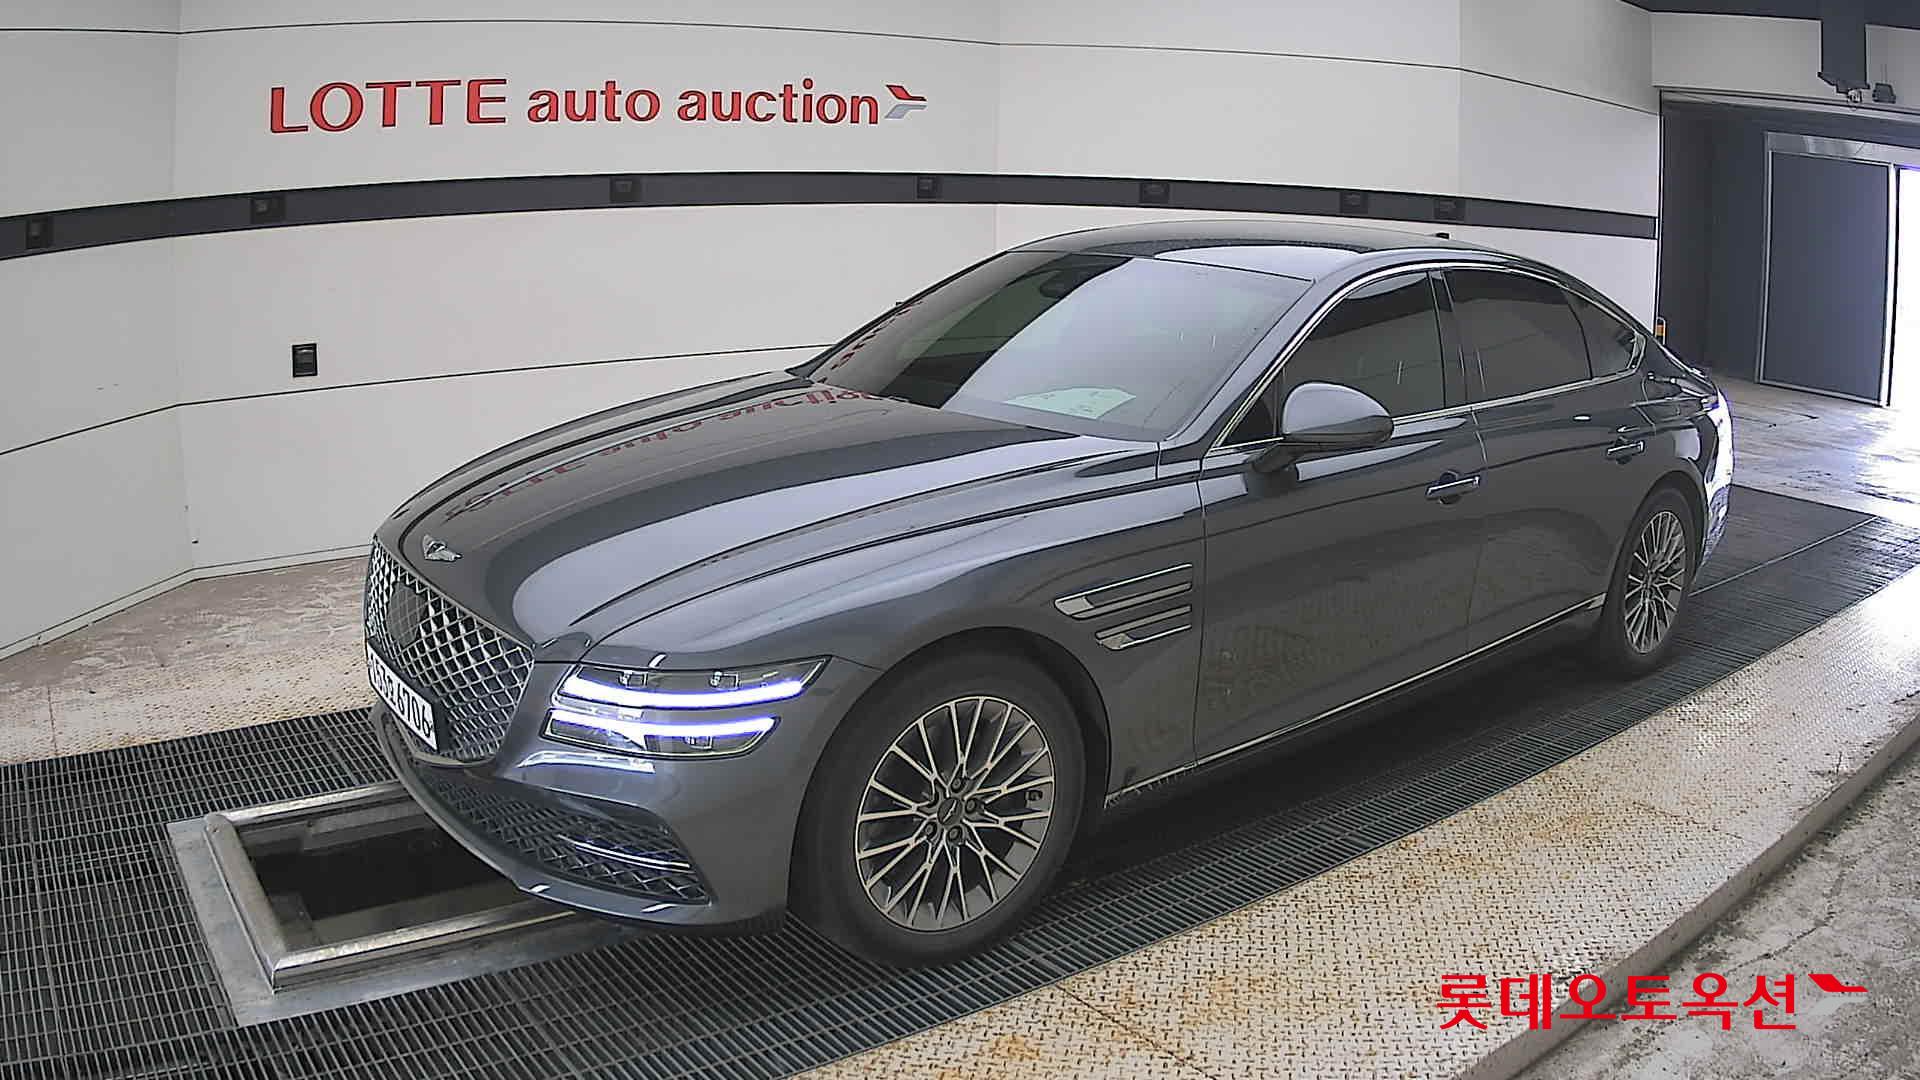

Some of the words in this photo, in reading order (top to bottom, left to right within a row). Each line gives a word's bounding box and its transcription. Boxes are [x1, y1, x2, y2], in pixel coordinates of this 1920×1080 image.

[270, 80, 507, 134] LOTTE
[528, 80, 660, 122] auto
[676, 77, 879, 126] auction
